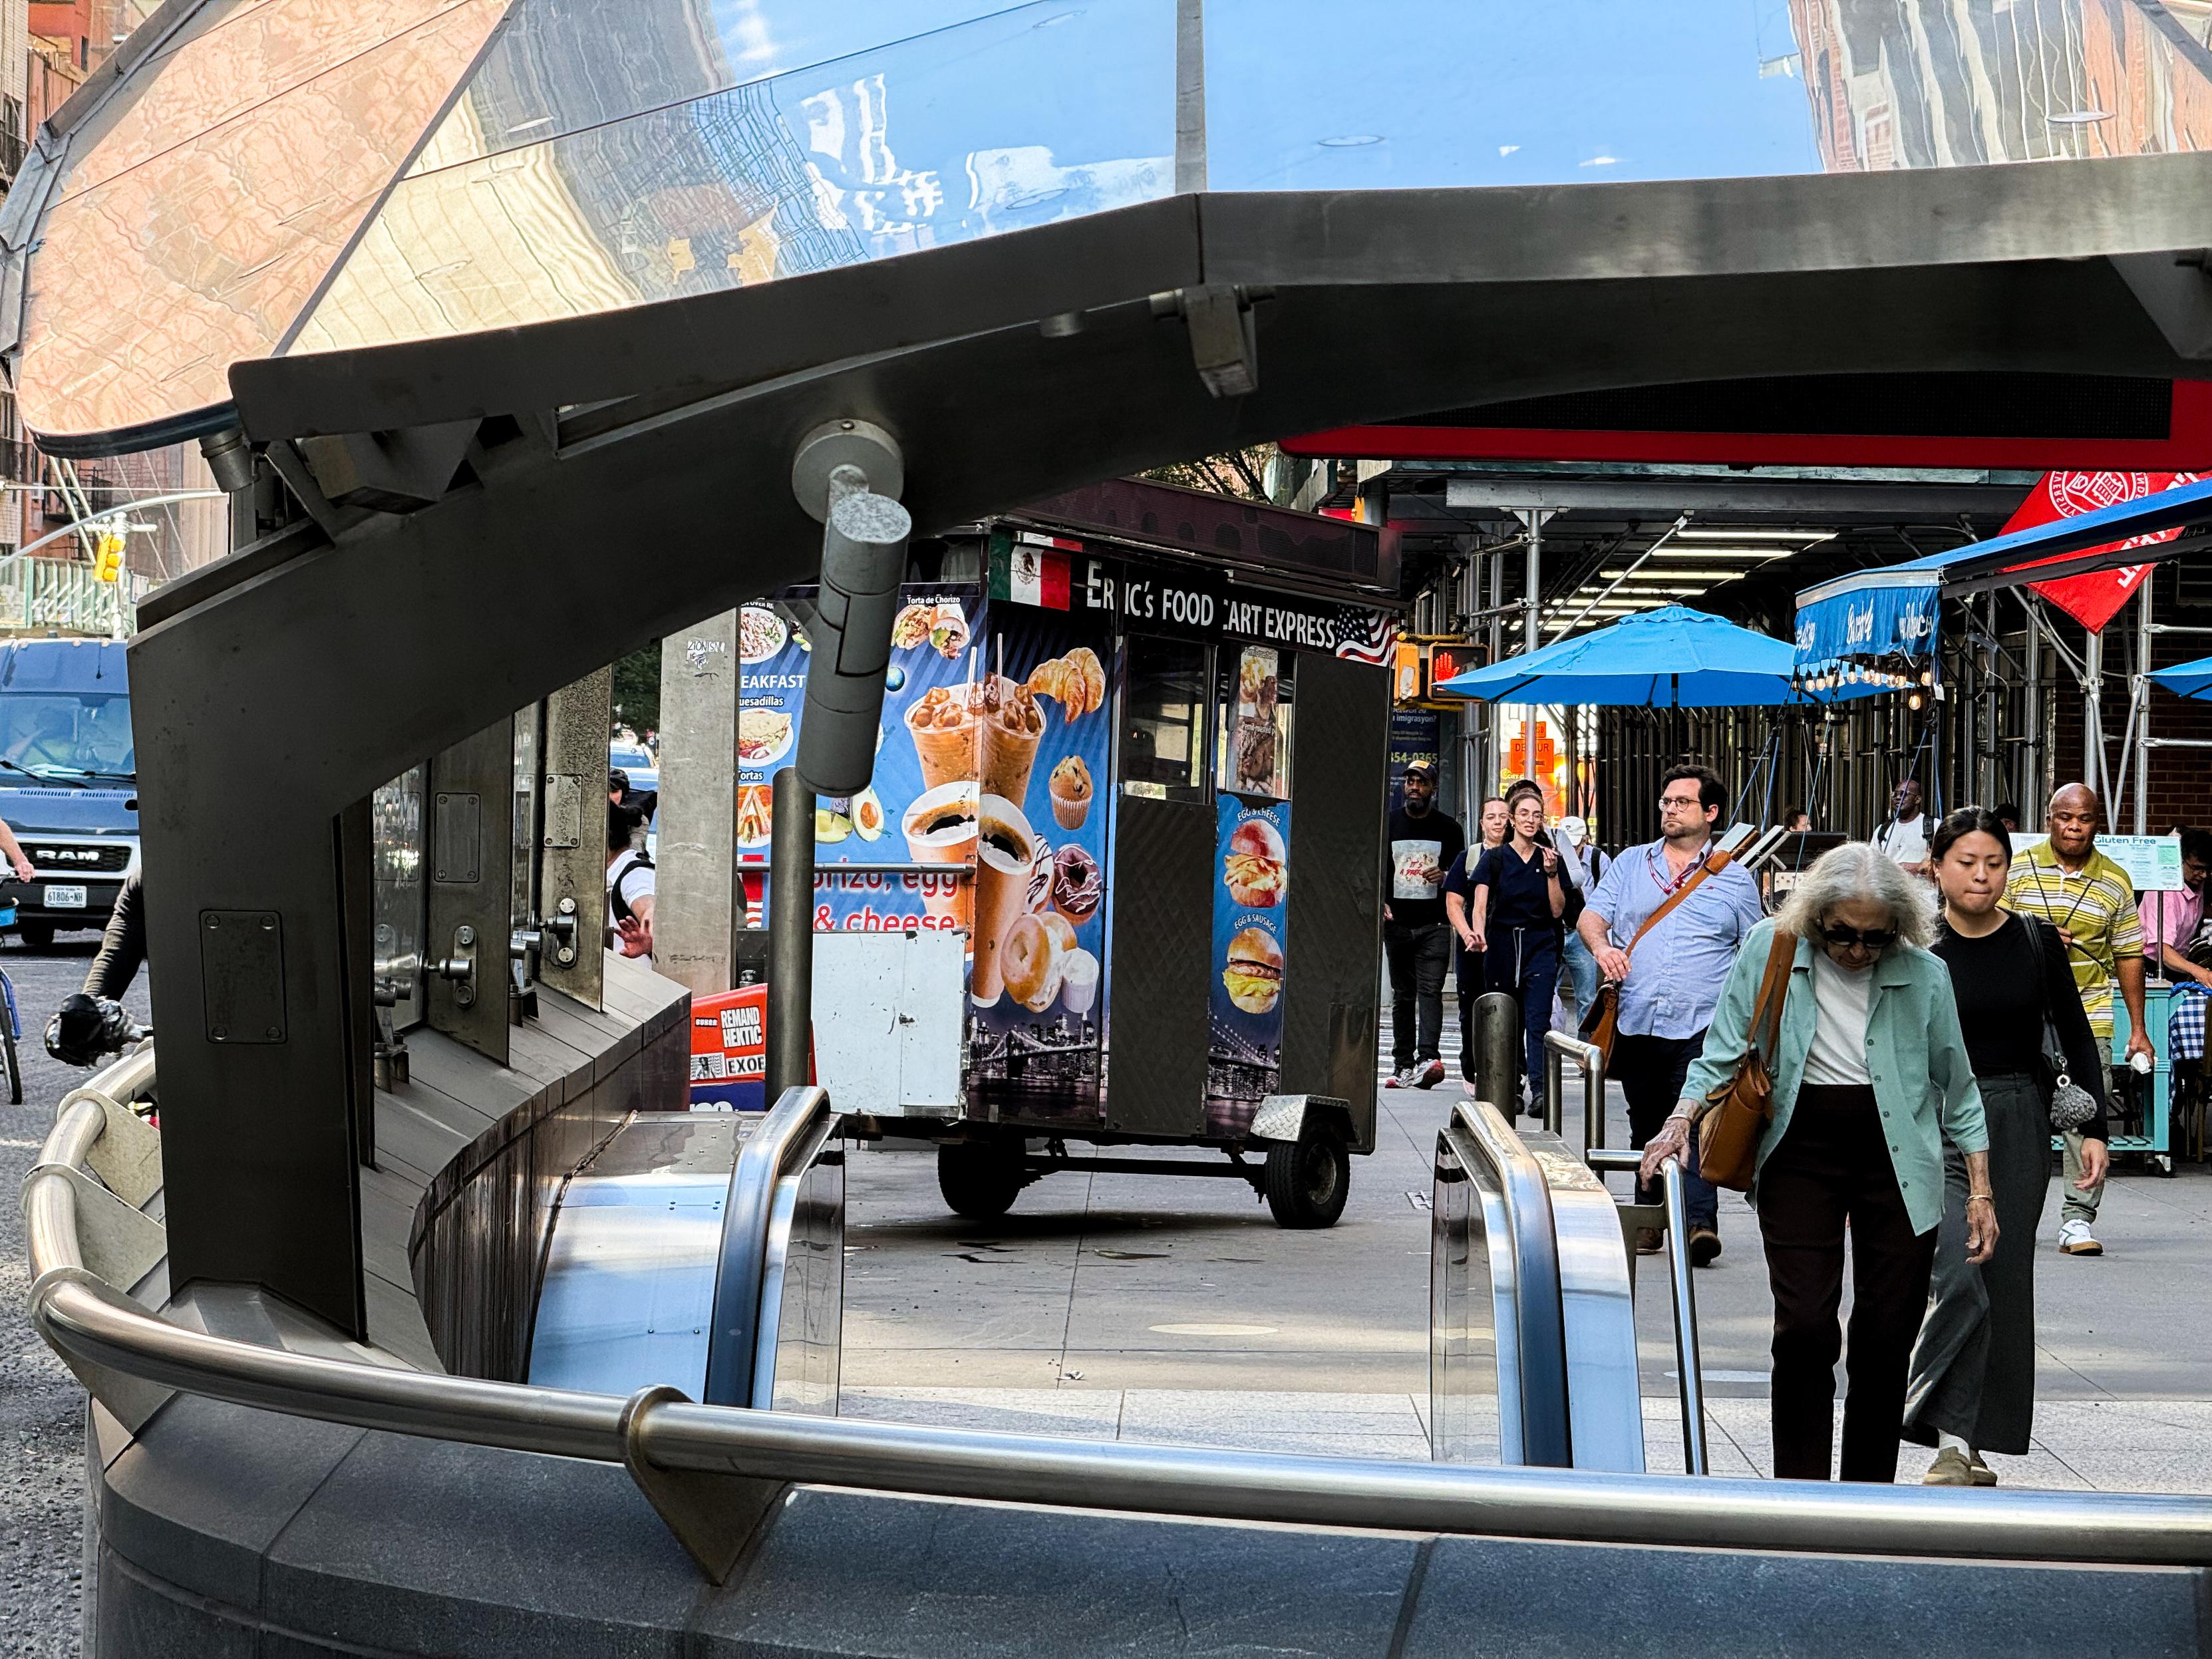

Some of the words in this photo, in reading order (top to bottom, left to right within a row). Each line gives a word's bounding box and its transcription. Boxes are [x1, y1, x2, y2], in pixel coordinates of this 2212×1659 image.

[906, 595, 925, 604] Torta
[925, 594, 934, 603] de
[935, 594, 961, 603] Chorizo
[1162, 589, 1214, 626] FOOD
[1265, 607, 1335, 649] EXPRESS
[741, 675, 806, 688] EAKFAST
[740, 696, 784, 706] uesadillas
[1515, 743, 1549, 752] DEUR
[37, 850, 100, 861] RAM
[903, 873, 959, 898] egg
[814, 905, 836, 931] &
[846, 906, 955, 931] cheese
[1234, 916, 1247, 930] EGG
[1247, 913, 1252, 923] &
[1252, 913, 1277, 935] SAUSAGE
[720, 1006, 760, 1028] REMAND
[722, 1025, 763, 1048] HEKTIC
